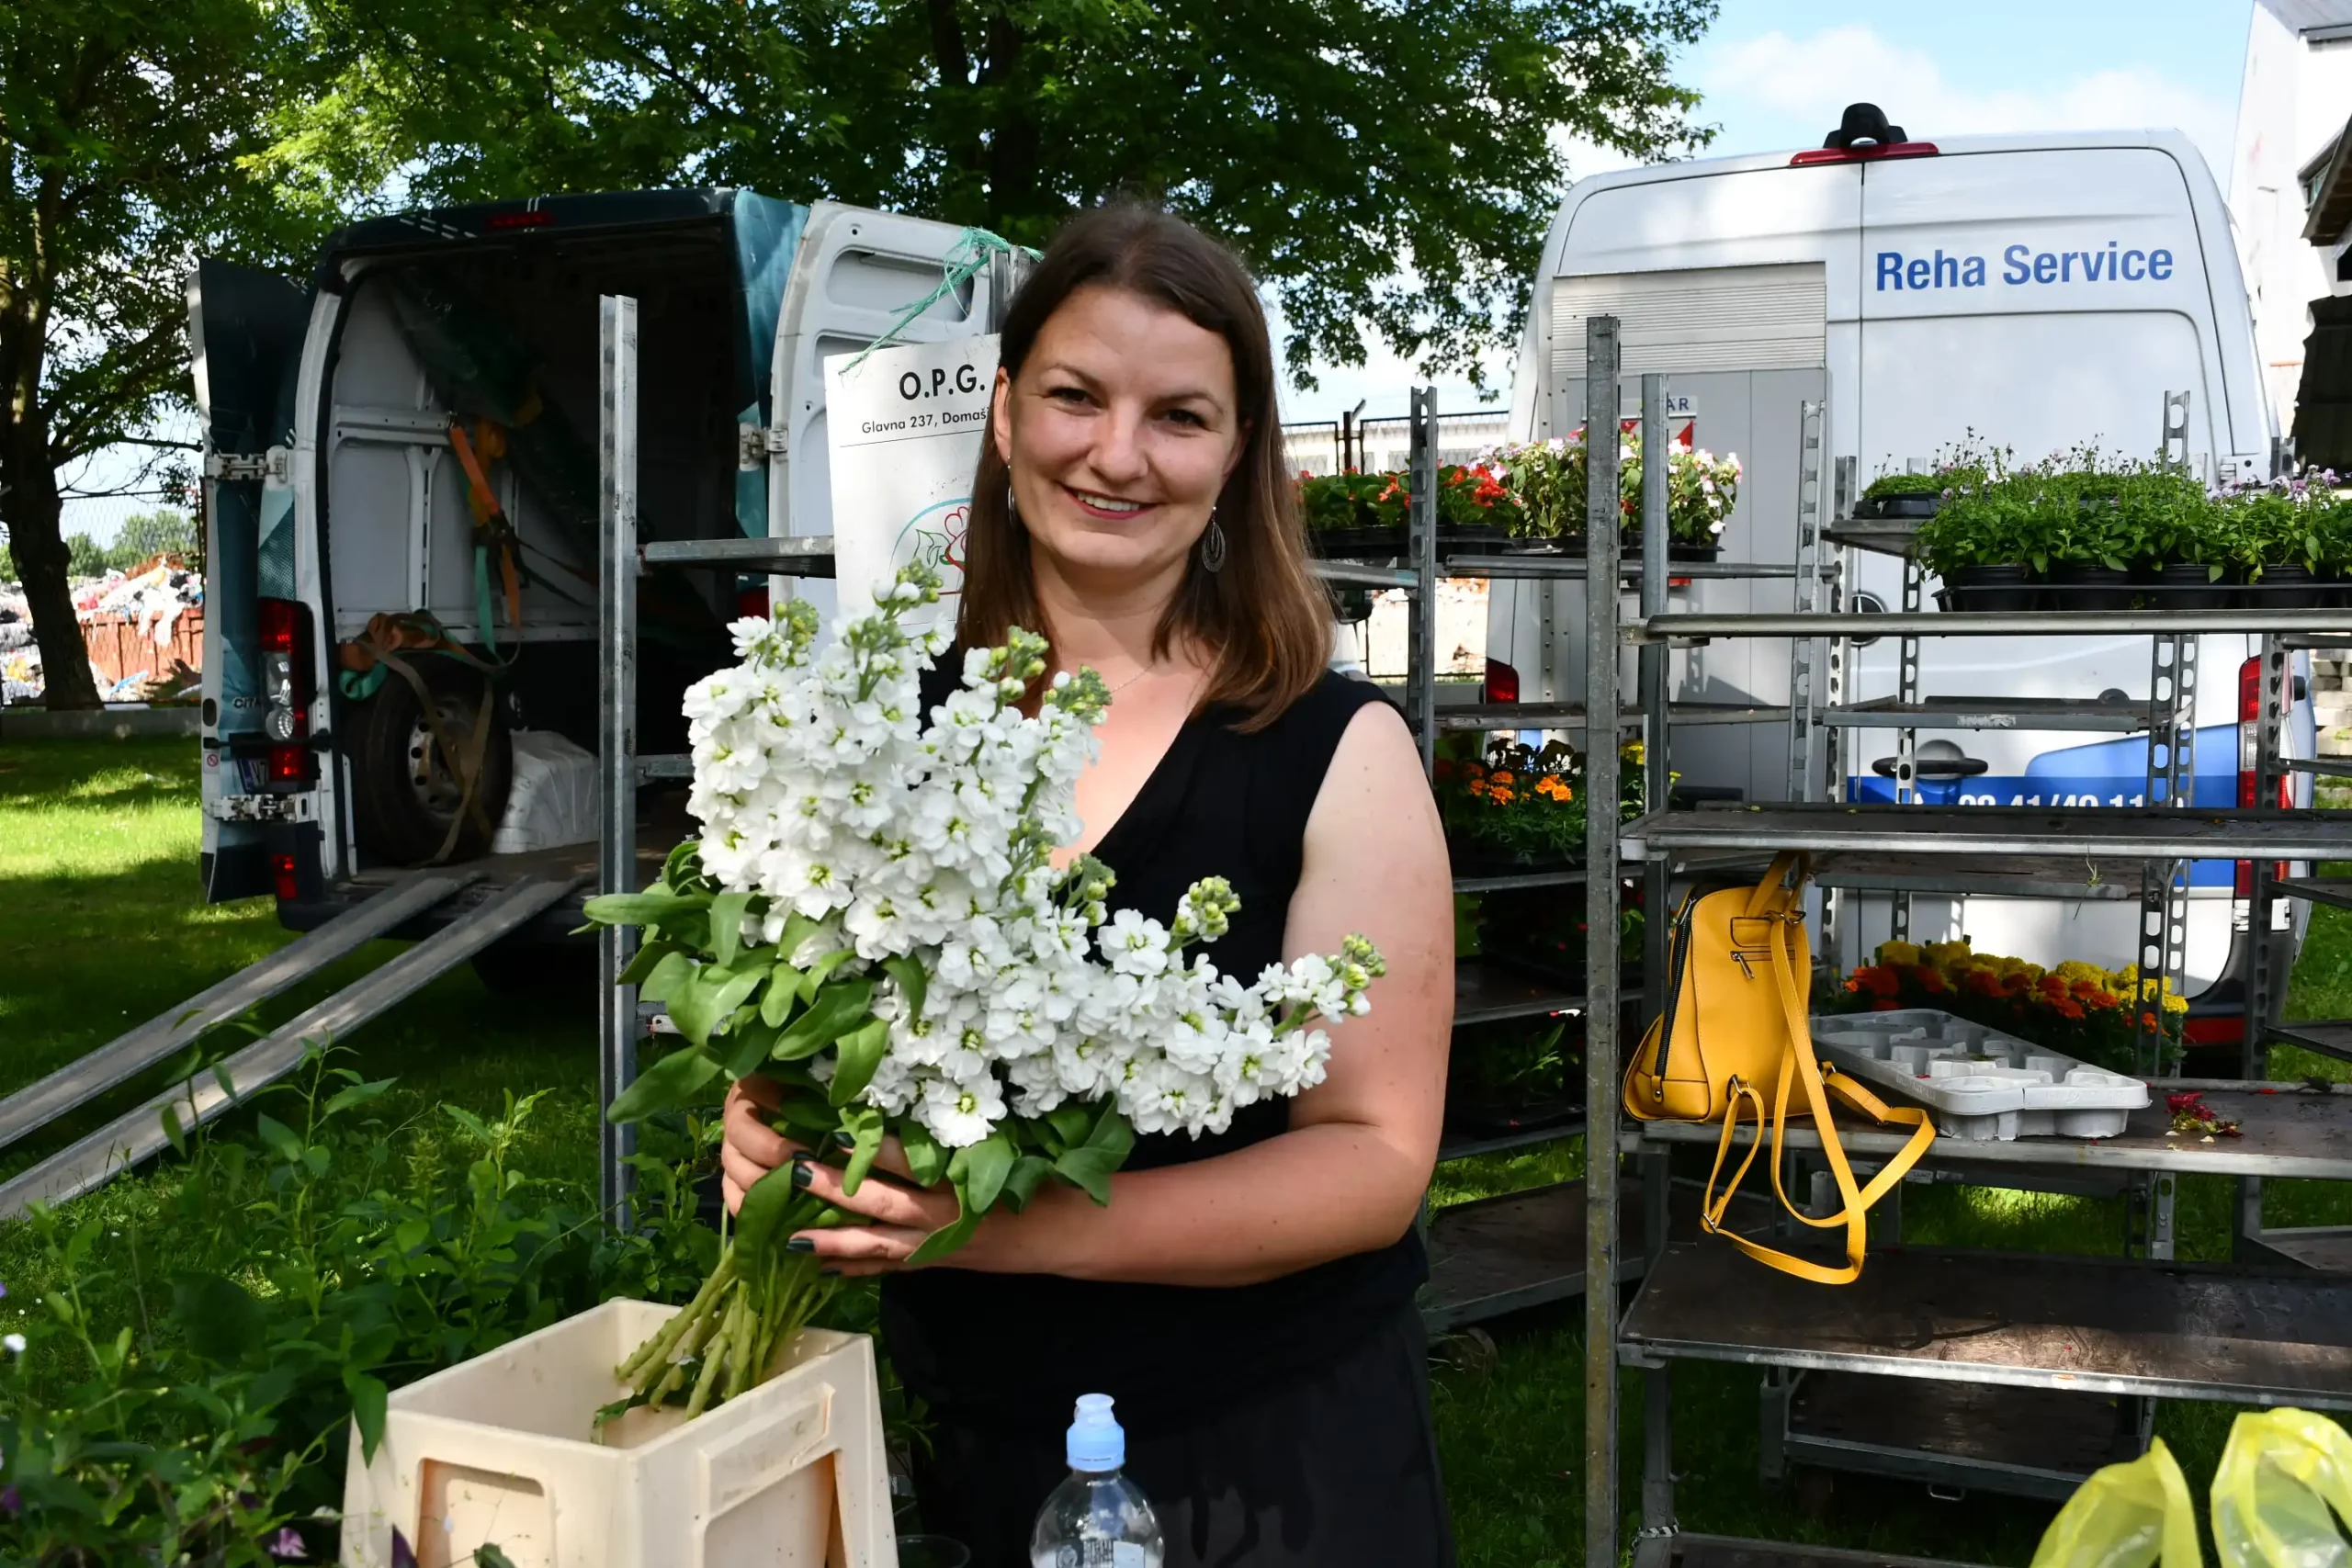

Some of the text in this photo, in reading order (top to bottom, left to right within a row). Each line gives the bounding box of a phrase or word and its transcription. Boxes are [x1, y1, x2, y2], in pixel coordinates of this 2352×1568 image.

[1876, 241, 2173, 291] Reha Service
[899, 365, 985, 400] O.P.G.
[863, 421, 906, 434] Glavna
[910, 415, 938, 427] 237,
